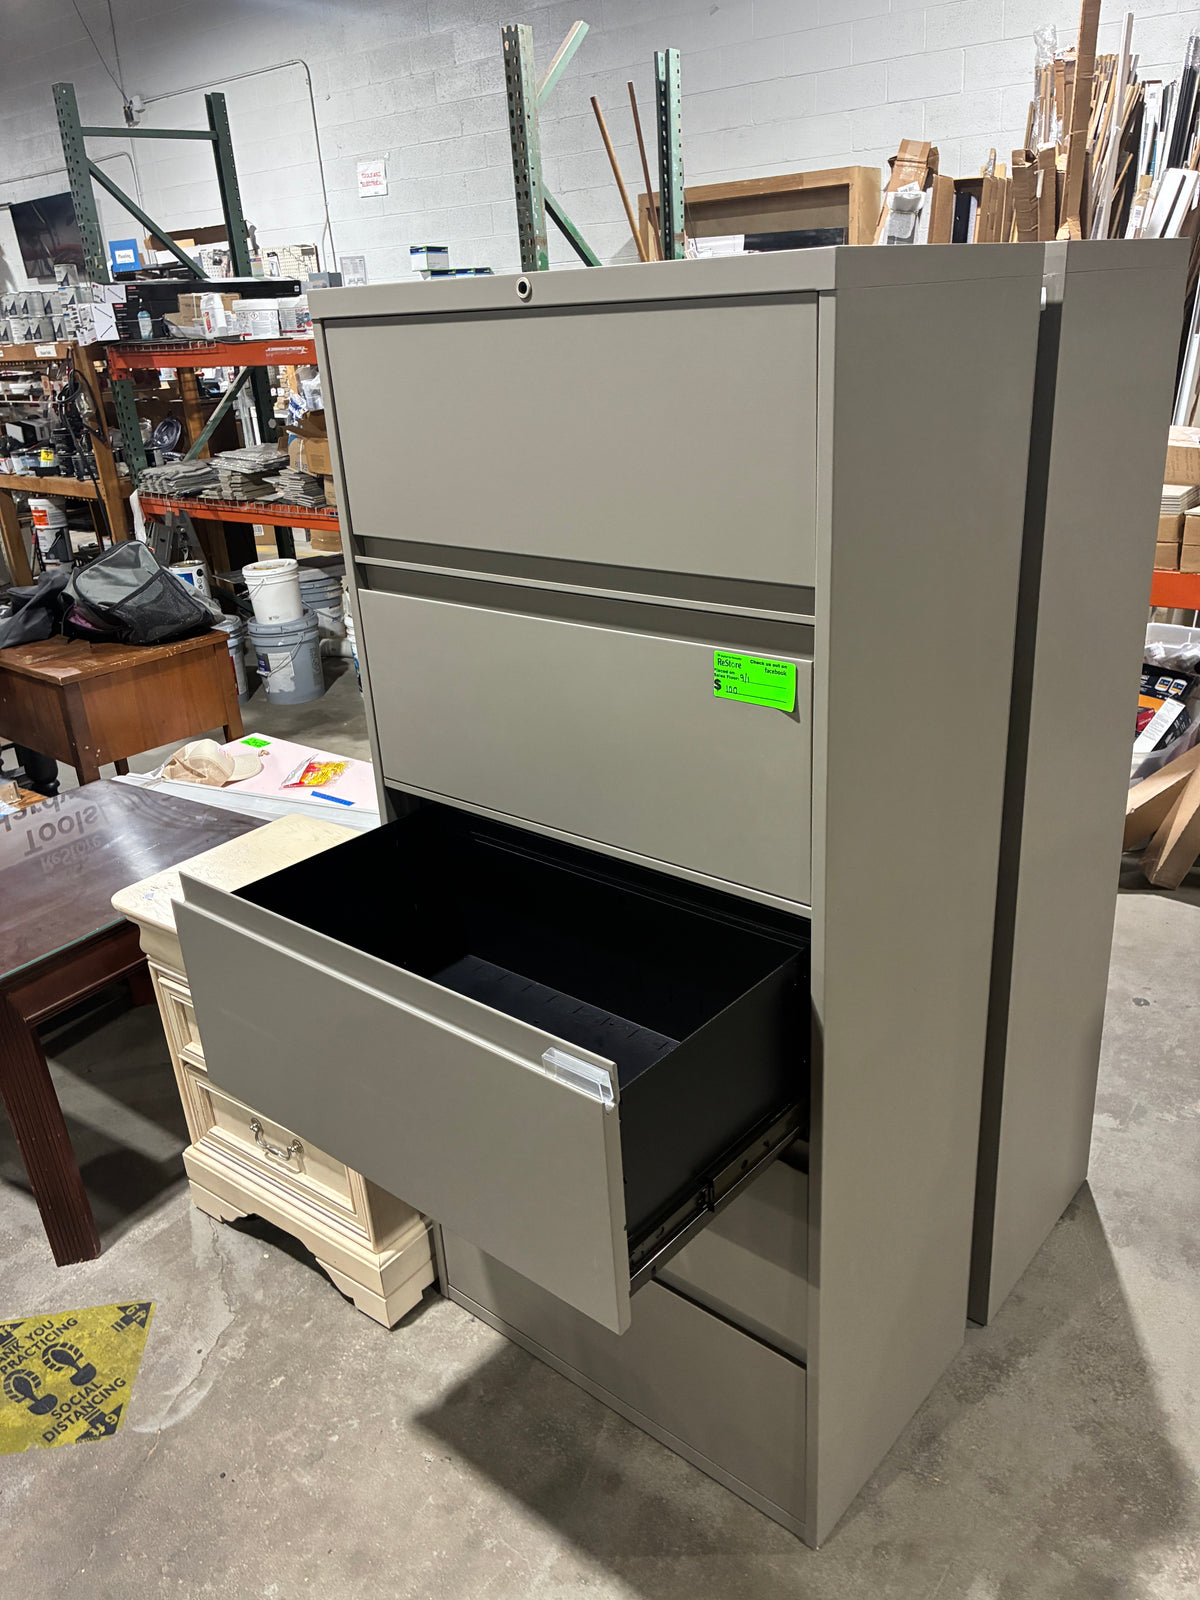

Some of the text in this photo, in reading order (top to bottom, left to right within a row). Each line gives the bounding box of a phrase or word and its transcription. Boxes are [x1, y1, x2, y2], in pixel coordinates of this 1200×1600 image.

[717, 657, 742, 669] ReStore
[764, 667, 787, 676] facebook
[714, 679, 722, 692] $
[24, 1319, 54, 1342] YOU
[0, 1317, 78, 1375] PRACTICING
[42, 1377, 126, 1443] DISTANCING
[51, 1380, 103, 1420] SOCIAL
